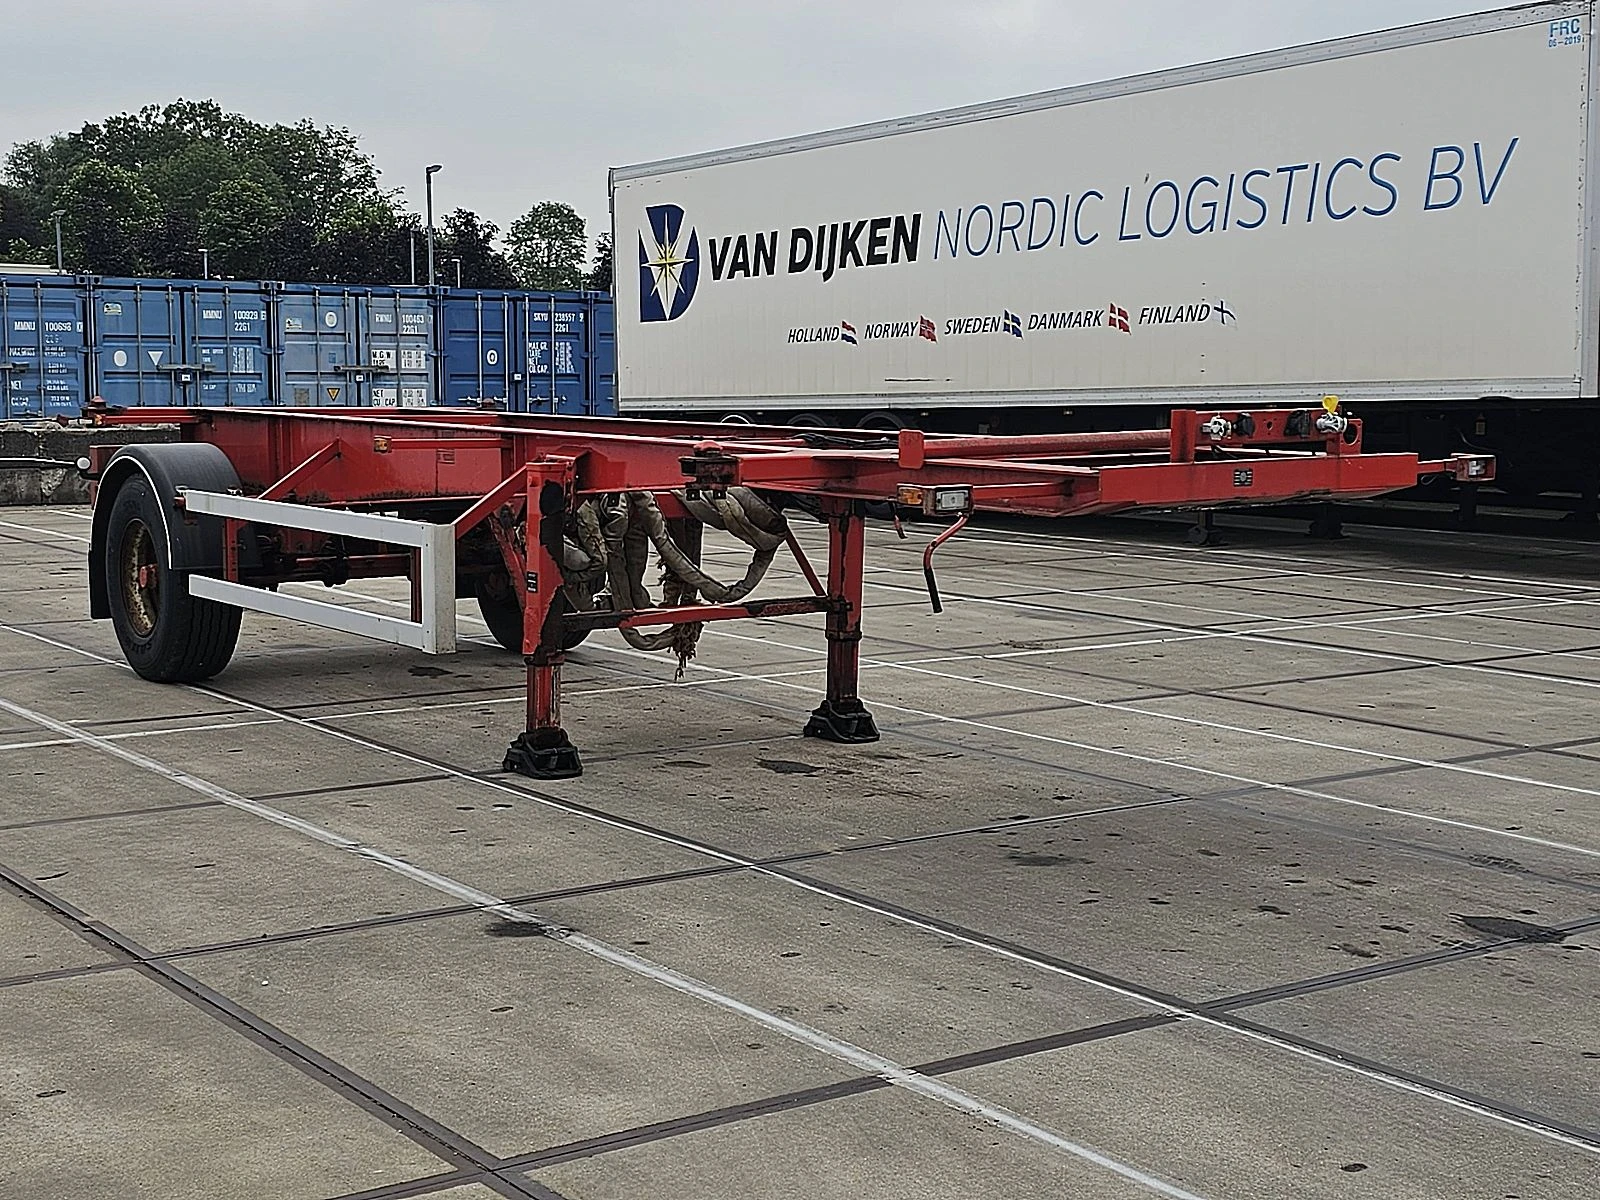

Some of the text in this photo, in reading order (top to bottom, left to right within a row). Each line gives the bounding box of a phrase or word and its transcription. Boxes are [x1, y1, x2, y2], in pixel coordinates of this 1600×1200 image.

[1550, 18, 1580, 37] FRC
[708, 137, 1520, 282] VAN DIJKEN NORDIC LOGISTICS BV
[787, 303, 1210, 343] HOLLAND NORWAY SWEDEN DANMARK FINLAND
